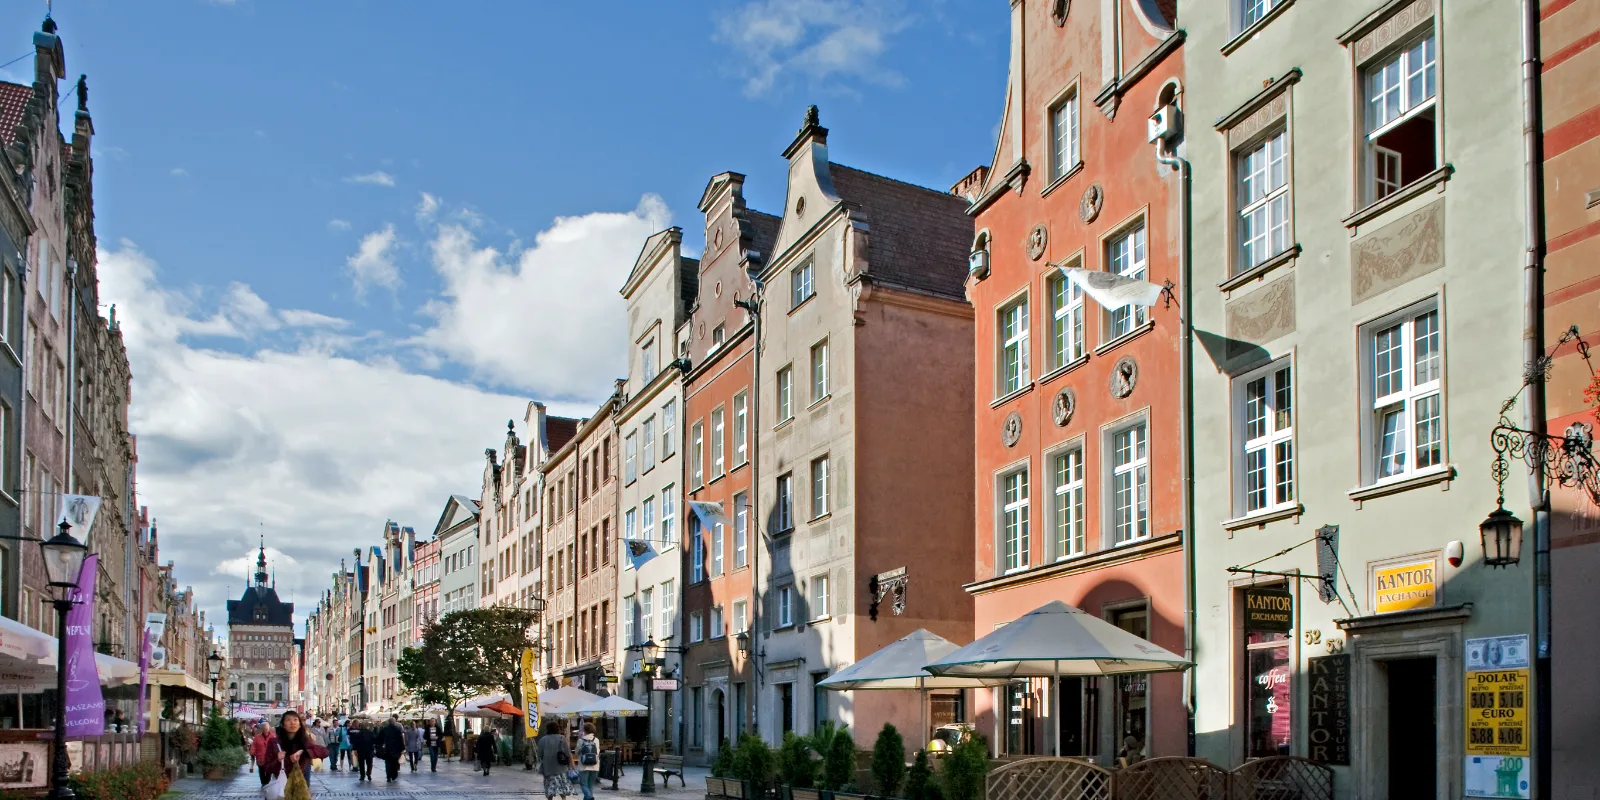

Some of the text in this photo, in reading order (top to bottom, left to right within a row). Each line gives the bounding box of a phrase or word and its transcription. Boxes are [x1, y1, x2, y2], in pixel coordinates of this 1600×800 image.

[1377, 568, 1433, 591] KANTOR
[1247, 594, 1291, 611] KANTOR
[1379, 589, 1432, 604] EXCHANGE
[1251, 612, 1289, 622] EXCHANGE
[1304, 629, 1321, 645] 52
[1325, 638, 1343, 654] 53
[1258, 669, 1286, 690] coffea
[1477, 673, 1517, 683] DOLAR
[65, 702, 104, 713] RASZAMY
[1311, 660, 1330, 760] KANTOR
[1481, 708, 1514, 719] €URO
[1502, 757, 1523, 771] 100
